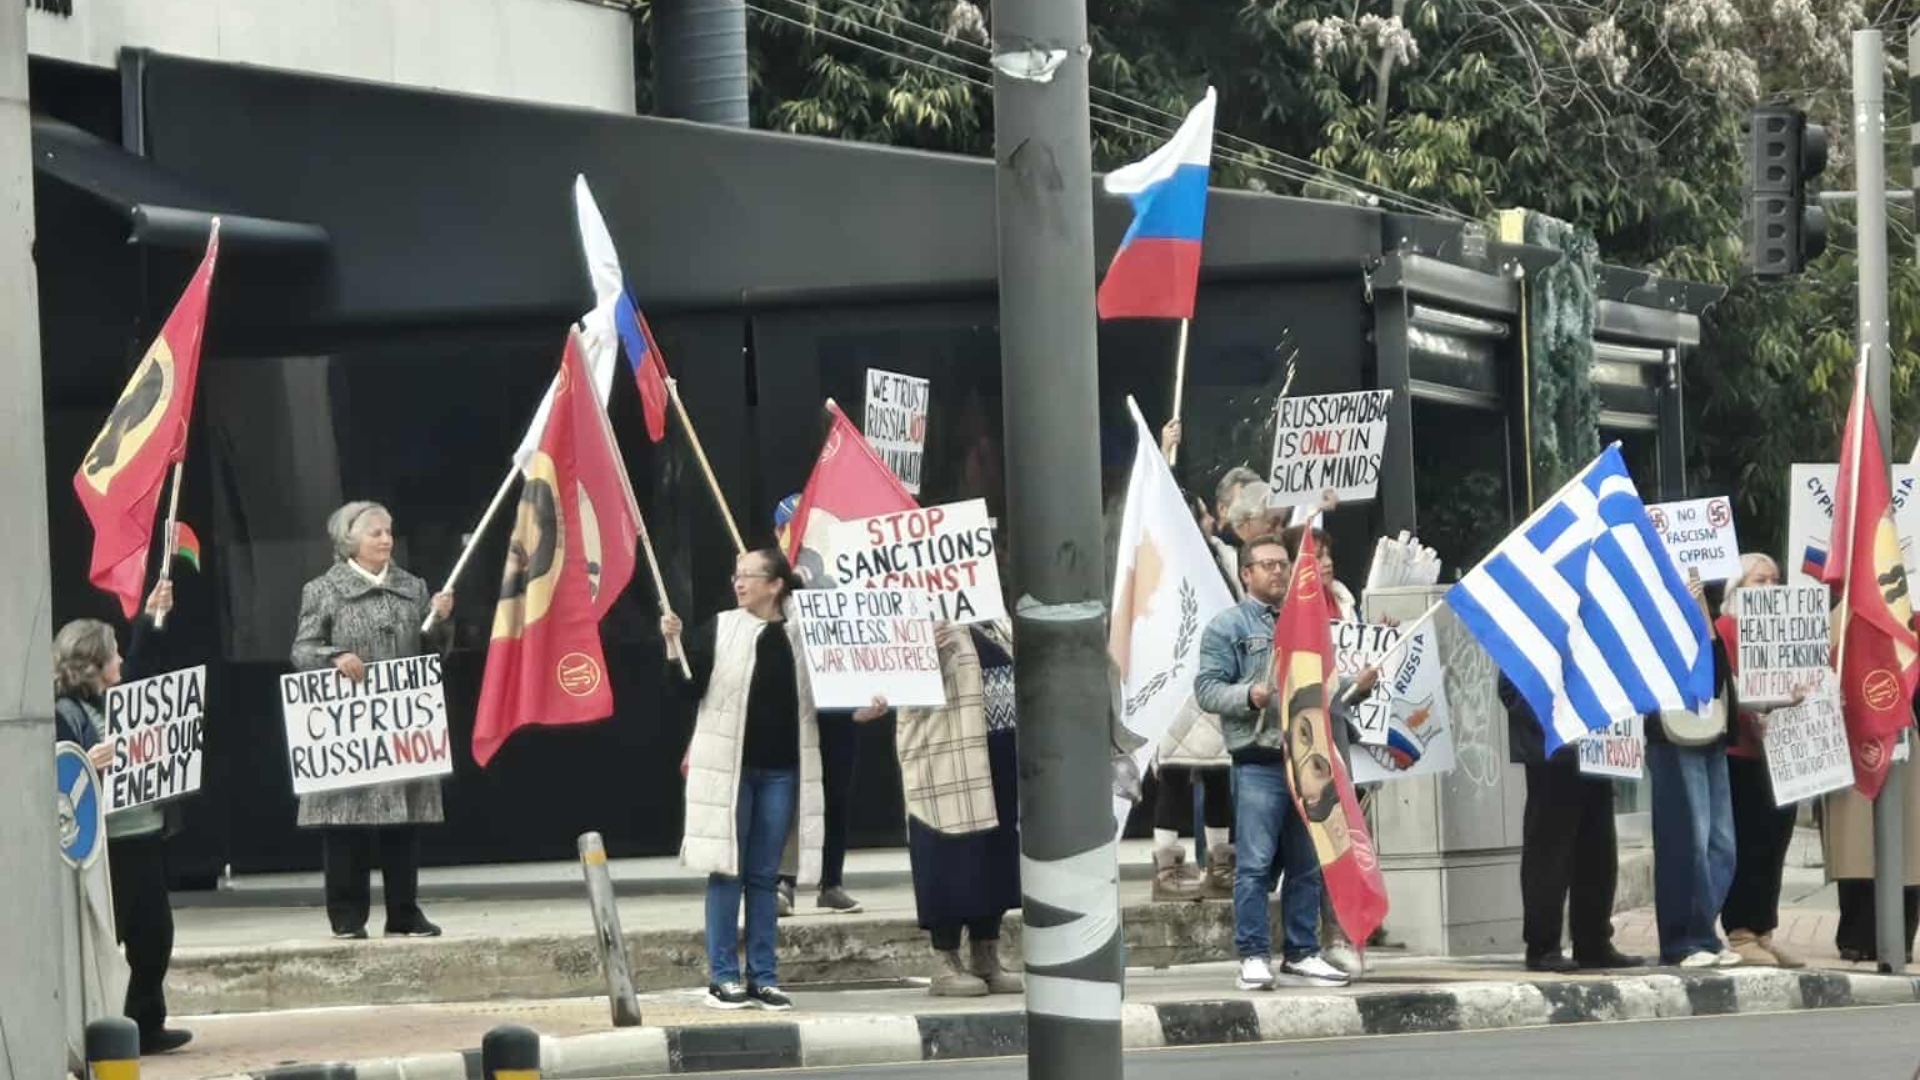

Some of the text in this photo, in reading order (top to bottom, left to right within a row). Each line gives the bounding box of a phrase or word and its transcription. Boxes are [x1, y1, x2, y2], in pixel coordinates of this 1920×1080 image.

[870, 372, 889, 402] WE
[1278, 427, 1370, 458] IS ONLY IN
[1271, 453, 1380, 493] SICK MINDS
[866, 508, 945, 545] STOP
[1677, 508, 1696, 521] NO
[1666, 527, 1718, 545] FASCISM
[836, 527, 992, 584] SANCTIONS
[1679, 546, 1725, 562] CYPRUS
[798, 592, 848, 618] HELP
[855, 591, 903, 616] POOR
[1743, 588, 1825, 616] MONEY FOR
[892, 618, 929, 643] NOT
[809, 646, 940, 672] WAR INDUSTRIES
[1394, 634, 1424, 694] RUSSIA
[1740, 645, 1768, 669] TION
[1779, 643, 1830, 667] PENSIONS
[1745, 671, 1767, 696] NOT
[109, 672, 202, 736] RUSSIA
[129, 724, 166, 767] NOT
[167, 717, 202, 754] OUR
[292, 728, 448, 779] RUSSIA NOW
[1580, 737, 1642, 768] FROM RUSSIA
[113, 751, 192, 808] ENEMY
